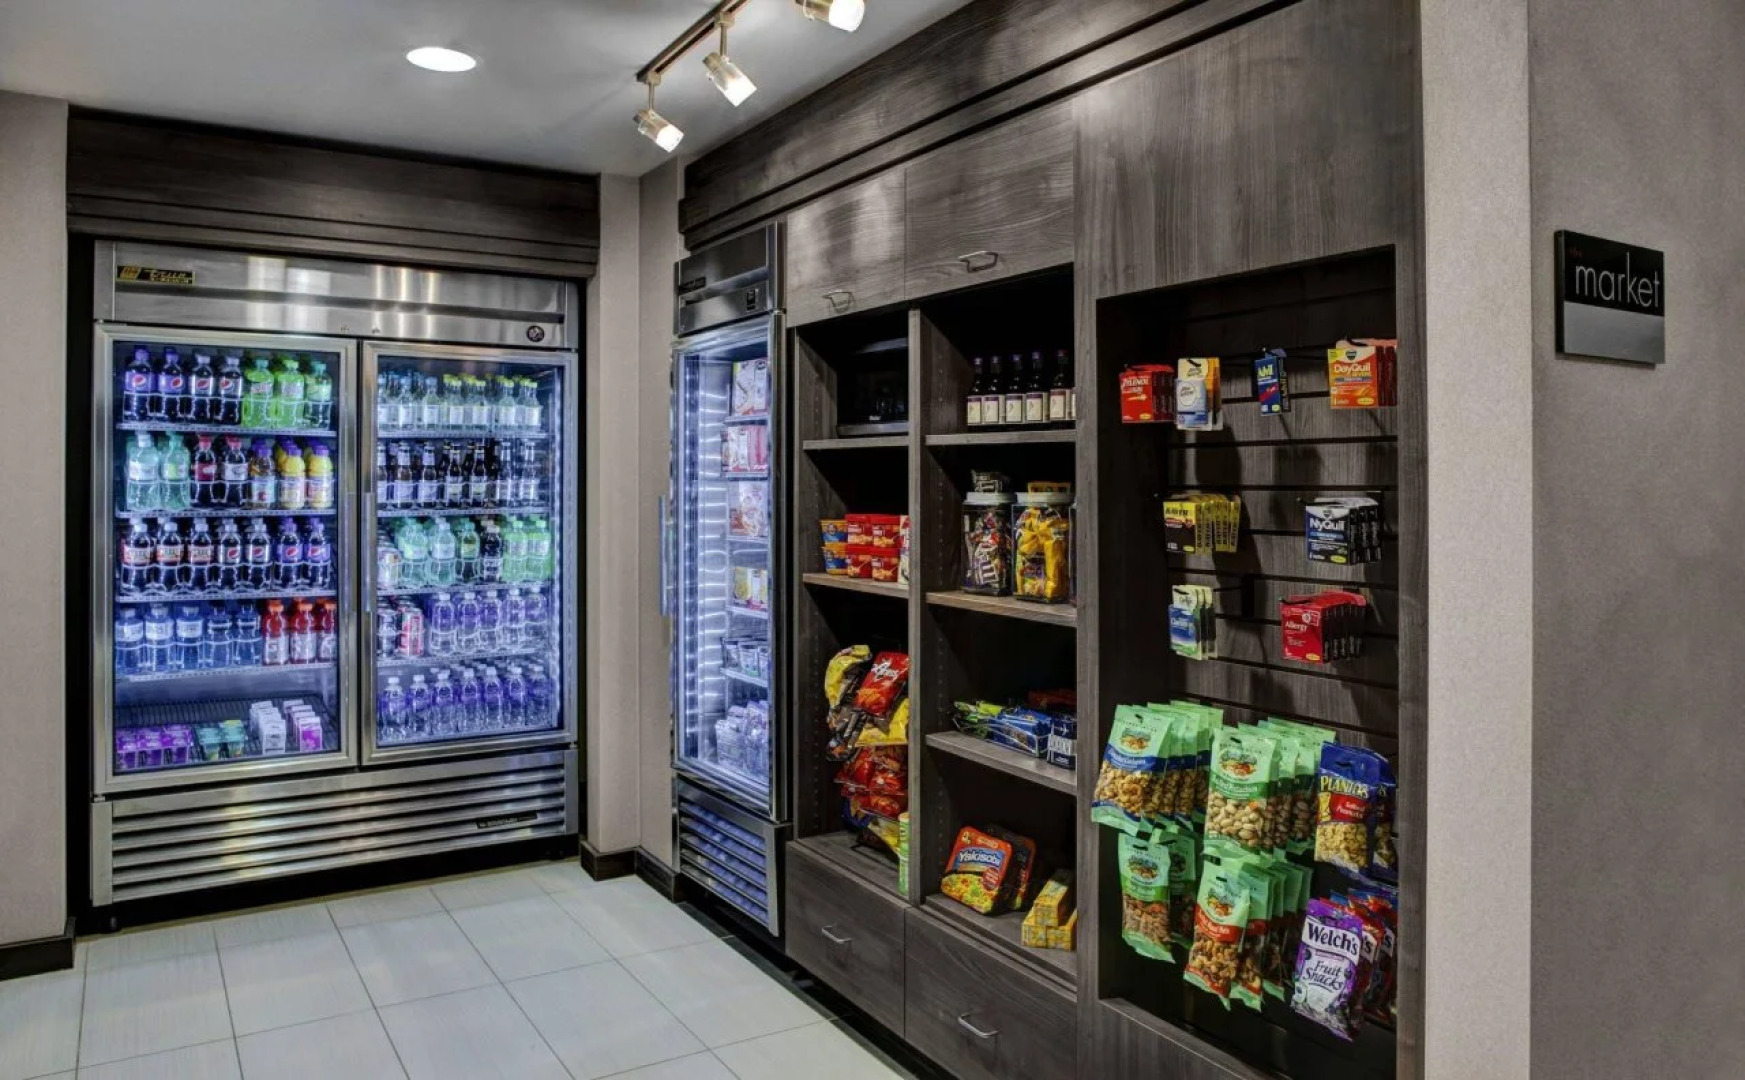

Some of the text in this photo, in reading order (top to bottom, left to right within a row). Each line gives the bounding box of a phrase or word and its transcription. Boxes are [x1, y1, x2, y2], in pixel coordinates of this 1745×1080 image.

[1575, 251, 1661, 308] market
[1334, 362, 1371, 376] DayQuil
[1309, 517, 1346, 531] NyQuil
[1308, 922, 1358, 956] Welch's
[1302, 967, 1344, 991] Snacks
[1314, 961, 1342, 977] Fruit
